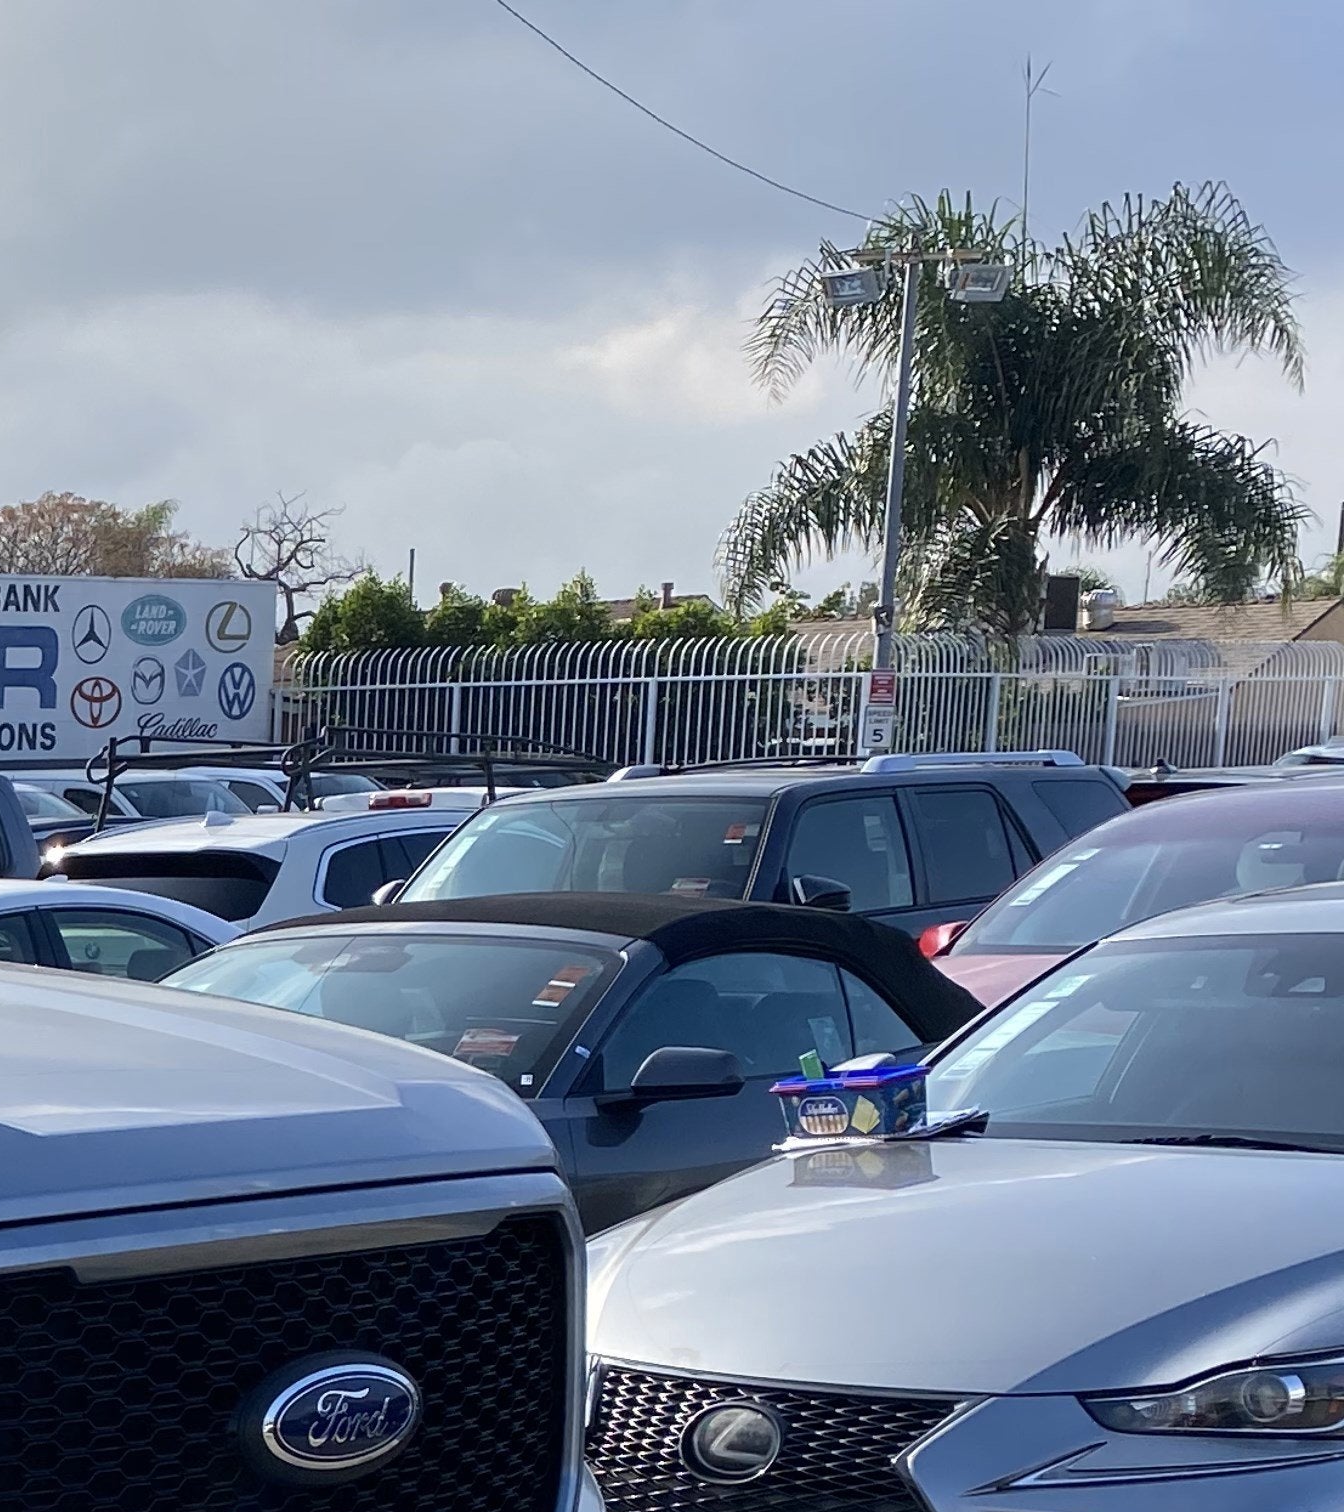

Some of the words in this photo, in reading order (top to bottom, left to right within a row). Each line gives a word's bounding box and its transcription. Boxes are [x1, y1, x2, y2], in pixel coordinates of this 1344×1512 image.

[137, 712, 218, 738] Cadillac
[872, 728, 883, 743] 5
[307, 1387, 390, 1448] Ford
